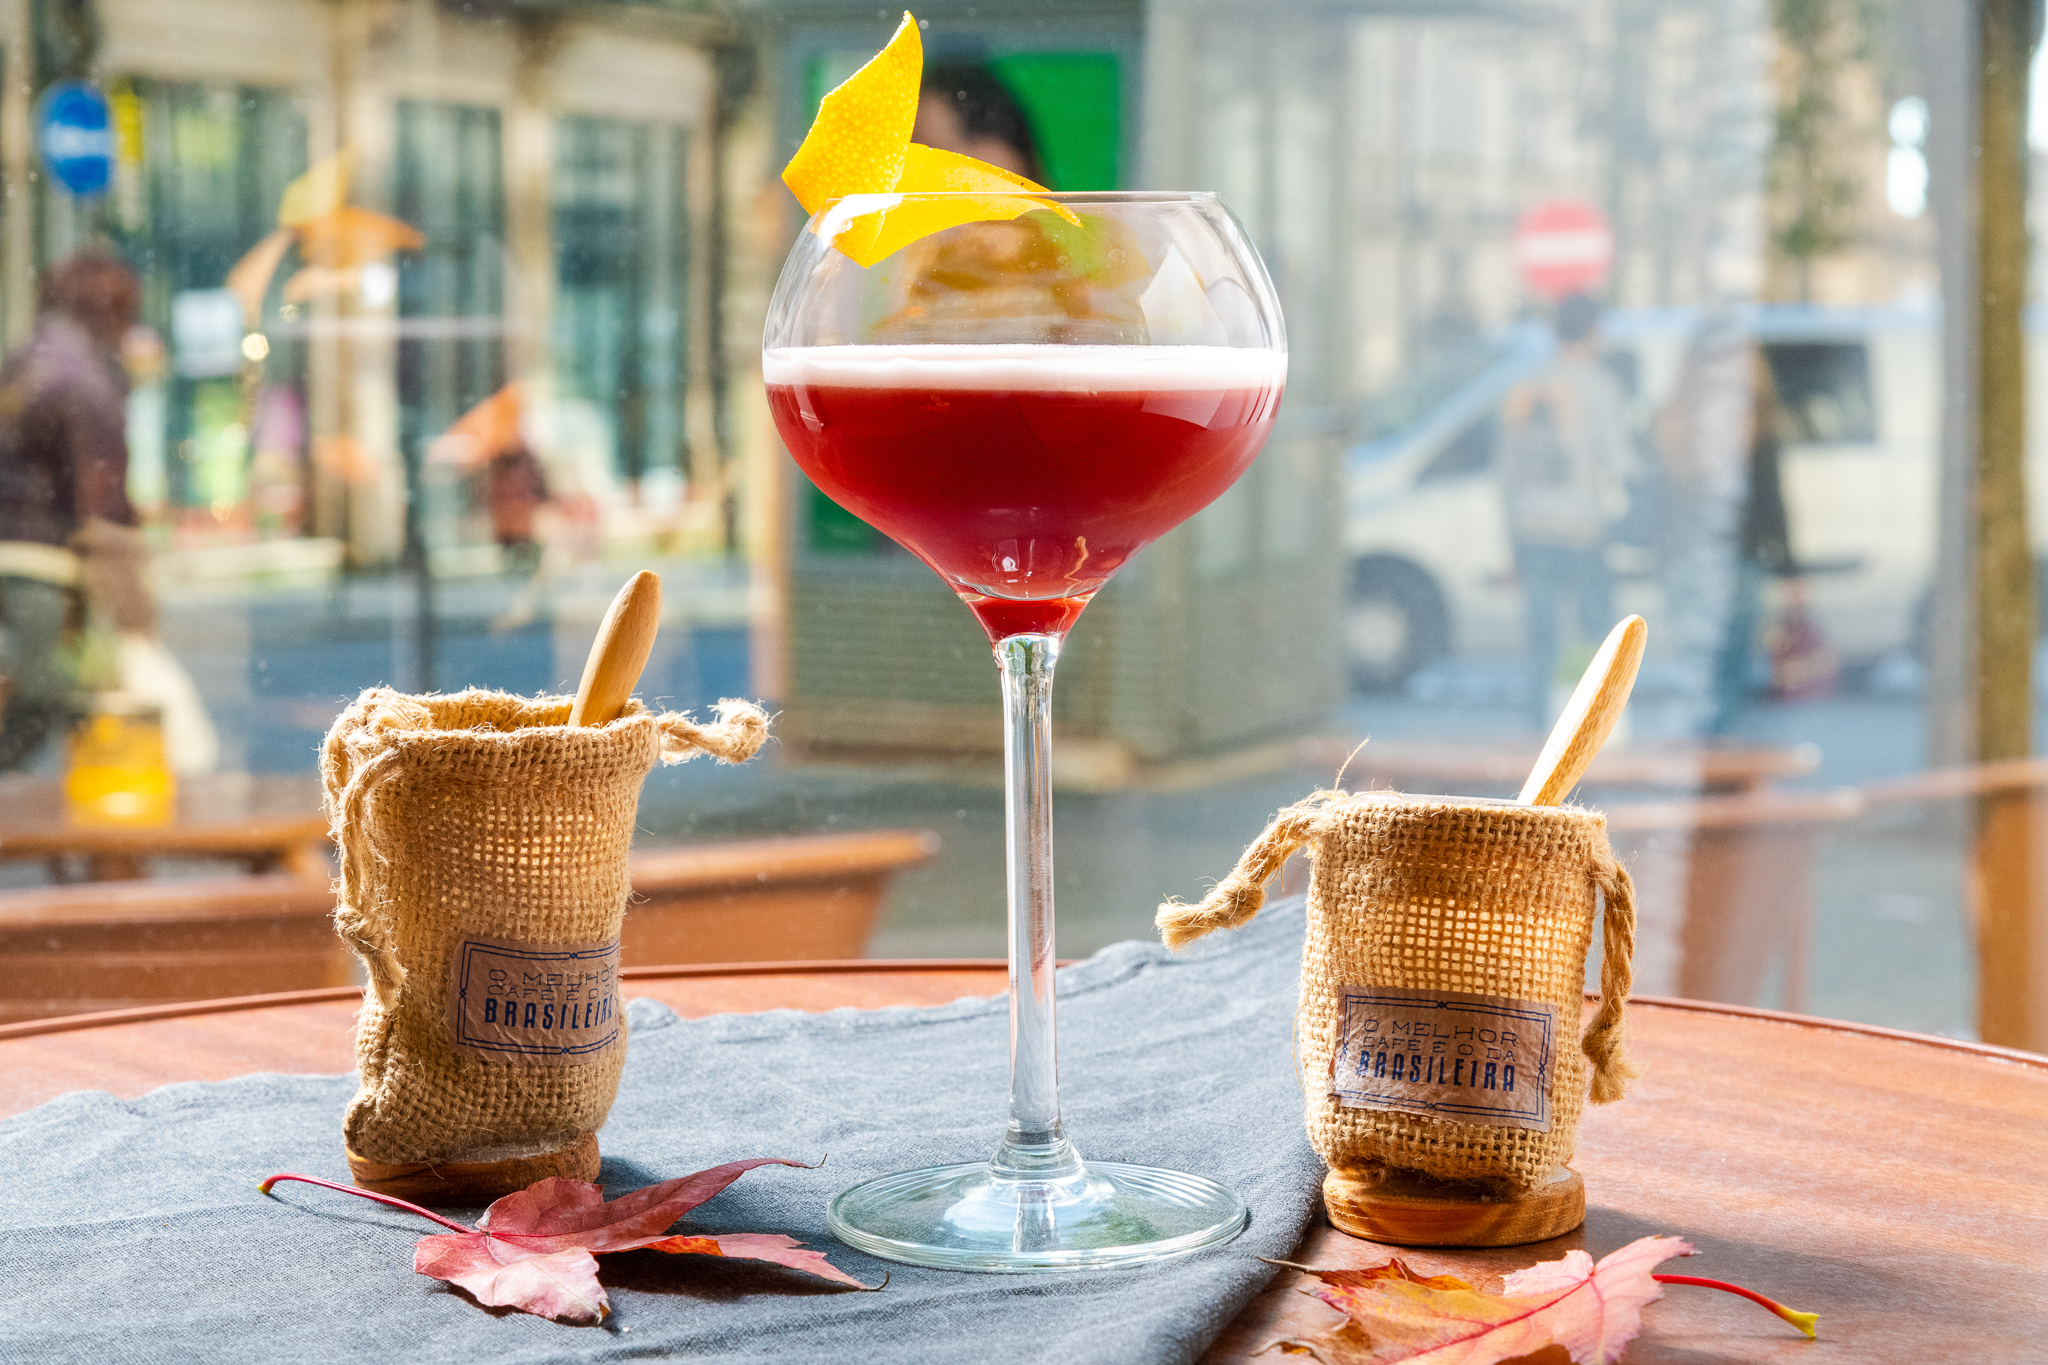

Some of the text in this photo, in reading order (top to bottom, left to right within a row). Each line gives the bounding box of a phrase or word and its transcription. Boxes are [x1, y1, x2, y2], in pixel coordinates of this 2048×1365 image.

[488, 969, 507, 982] O
[588, 988, 599, 1000] O
[1364, 1019, 1518, 1047] O MELHOR
[1363, 1036, 1421, 1052] CAFÉ
[1458, 1044, 1474, 1056] O
[1487, 1048, 1516, 1062] DA
[1356, 1050, 1515, 1092] BRASILEIRA
